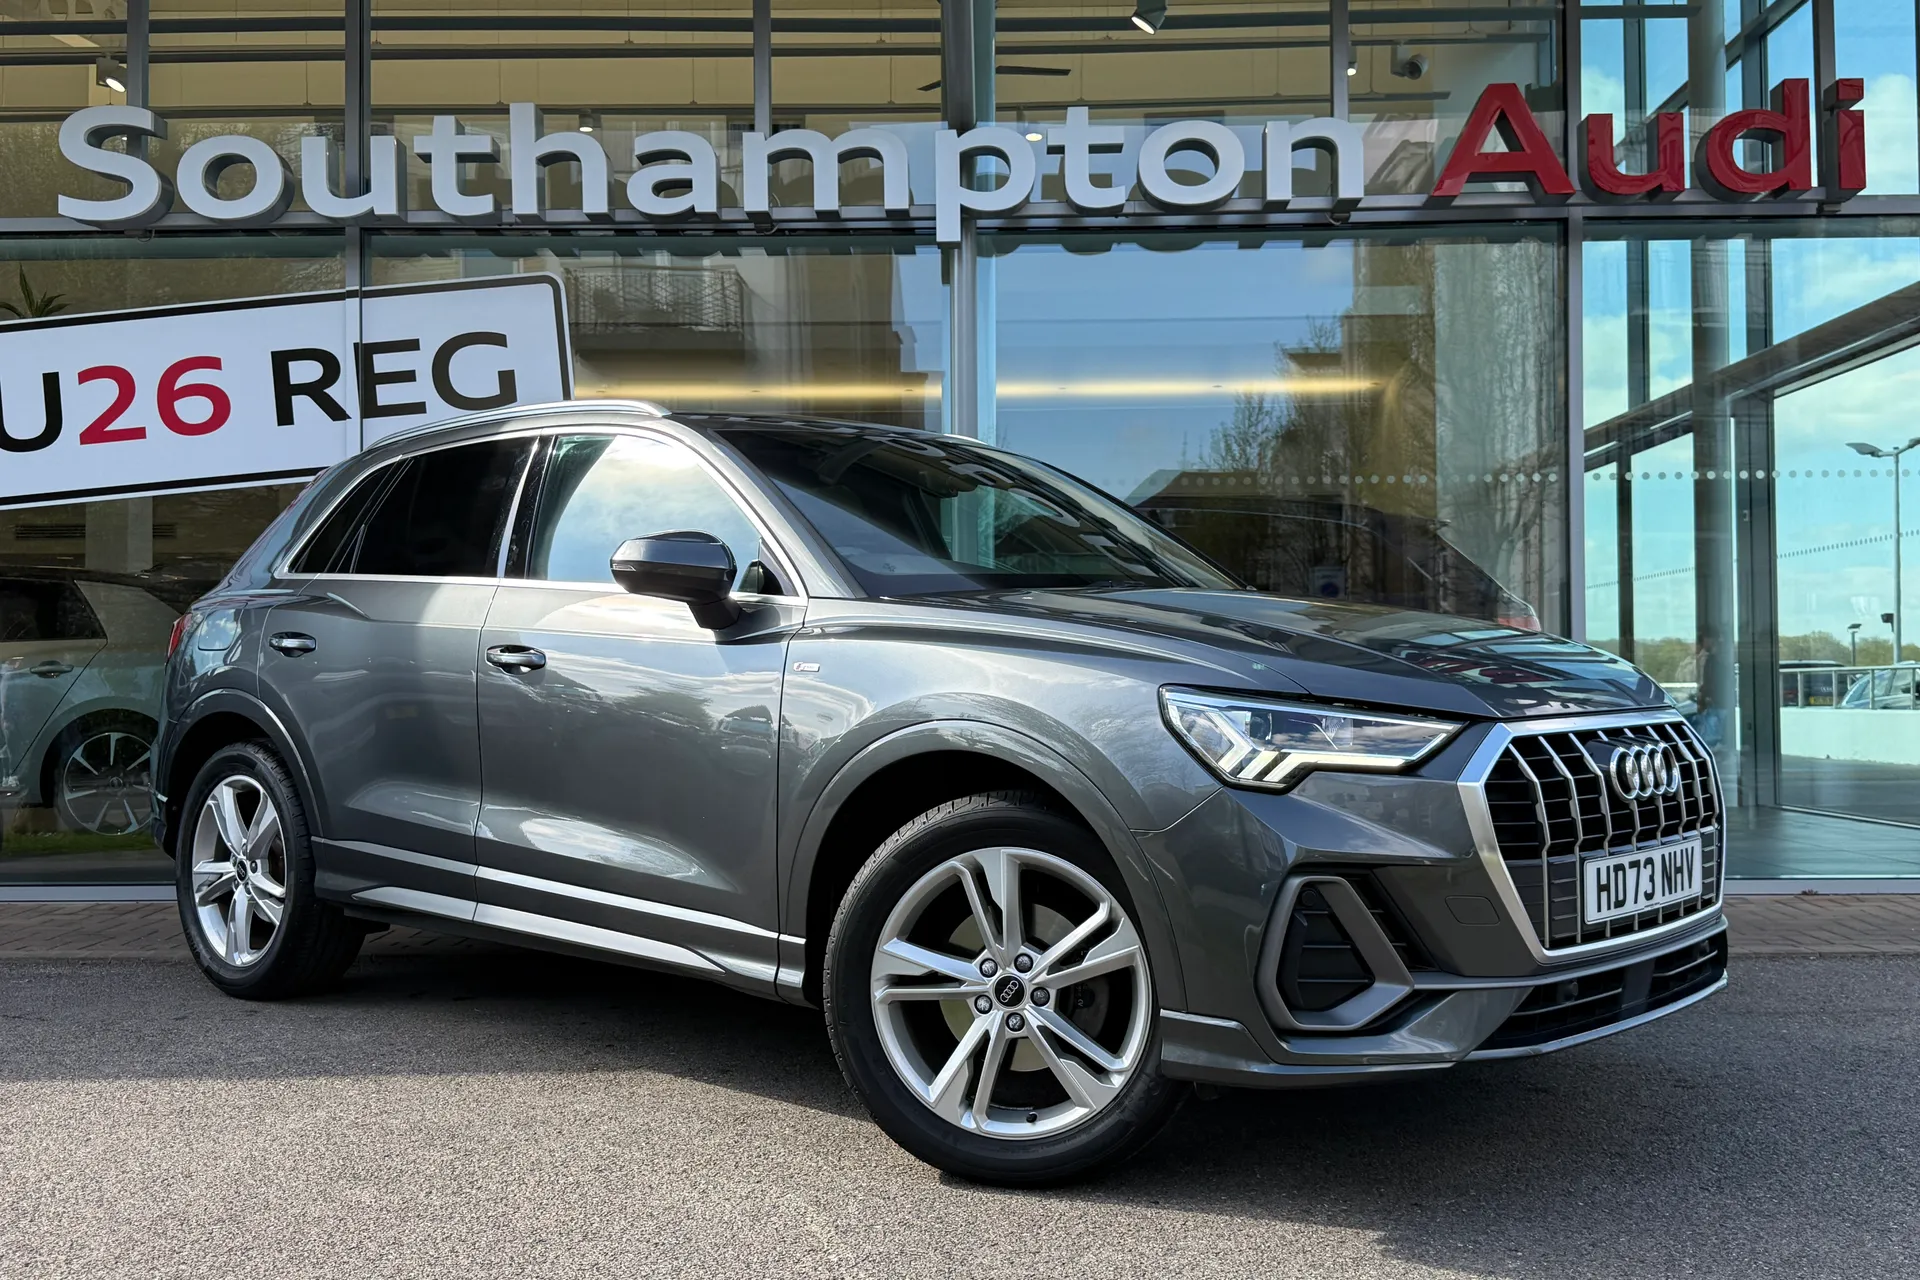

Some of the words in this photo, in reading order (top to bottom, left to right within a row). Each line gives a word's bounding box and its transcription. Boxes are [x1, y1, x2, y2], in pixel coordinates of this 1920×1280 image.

[57, 102, 1364, 243] Southampton
[1431, 77, 1867, 196] Audi
[0, 355, 232, 453] U26
[270, 331, 518, 427] REG
[1596, 856, 1656, 913] HD73
[1661, 846, 1695, 897] NHV
